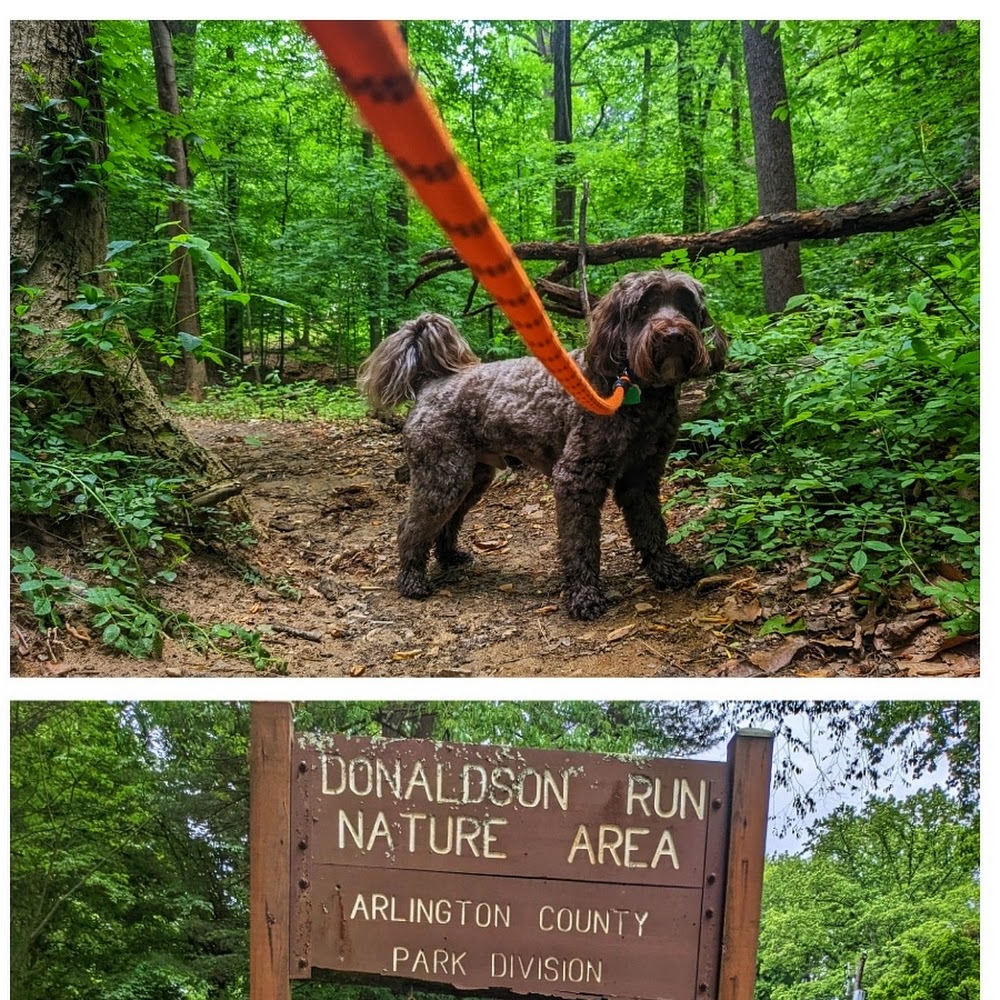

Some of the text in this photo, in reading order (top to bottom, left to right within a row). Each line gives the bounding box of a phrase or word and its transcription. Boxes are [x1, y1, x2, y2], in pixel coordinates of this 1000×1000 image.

[321, 755, 707, 821] DONALDSON RUN
[338, 810, 680, 870] NATURE AREA
[350, 894, 649, 937] ARLINGTON COUNTY
[392, 947, 603, 984] PARK DIVISION
